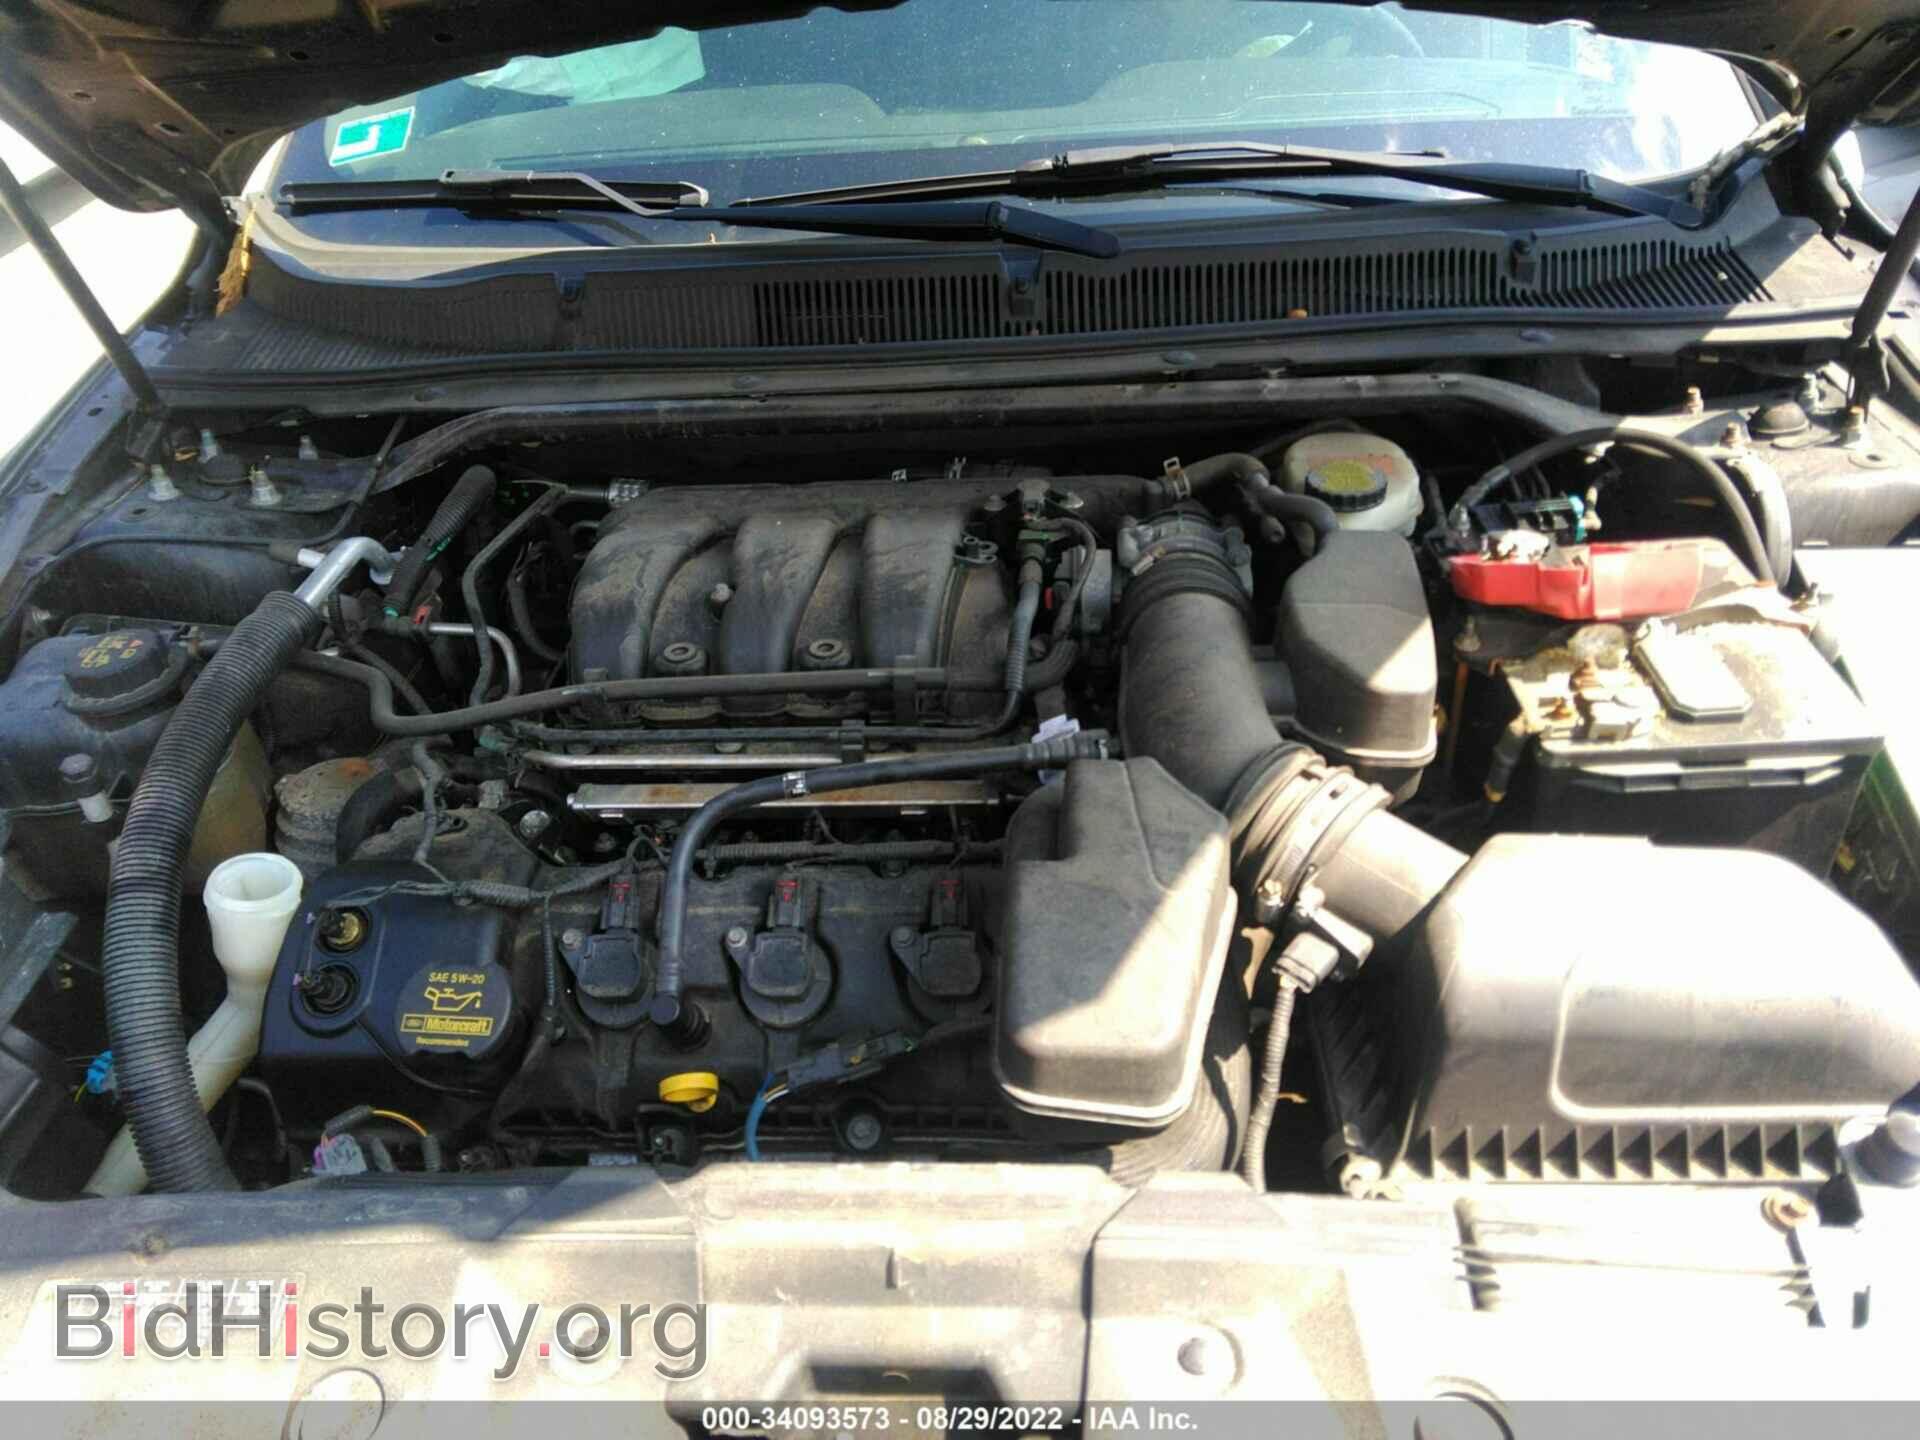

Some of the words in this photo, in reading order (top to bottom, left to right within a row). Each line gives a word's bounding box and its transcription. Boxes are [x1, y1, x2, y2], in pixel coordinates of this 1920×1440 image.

[428, 971, 449, 983] SAE
[450, 972, 485, 984] 5W-20
[426, 1016, 488, 1033] Motorcraft
